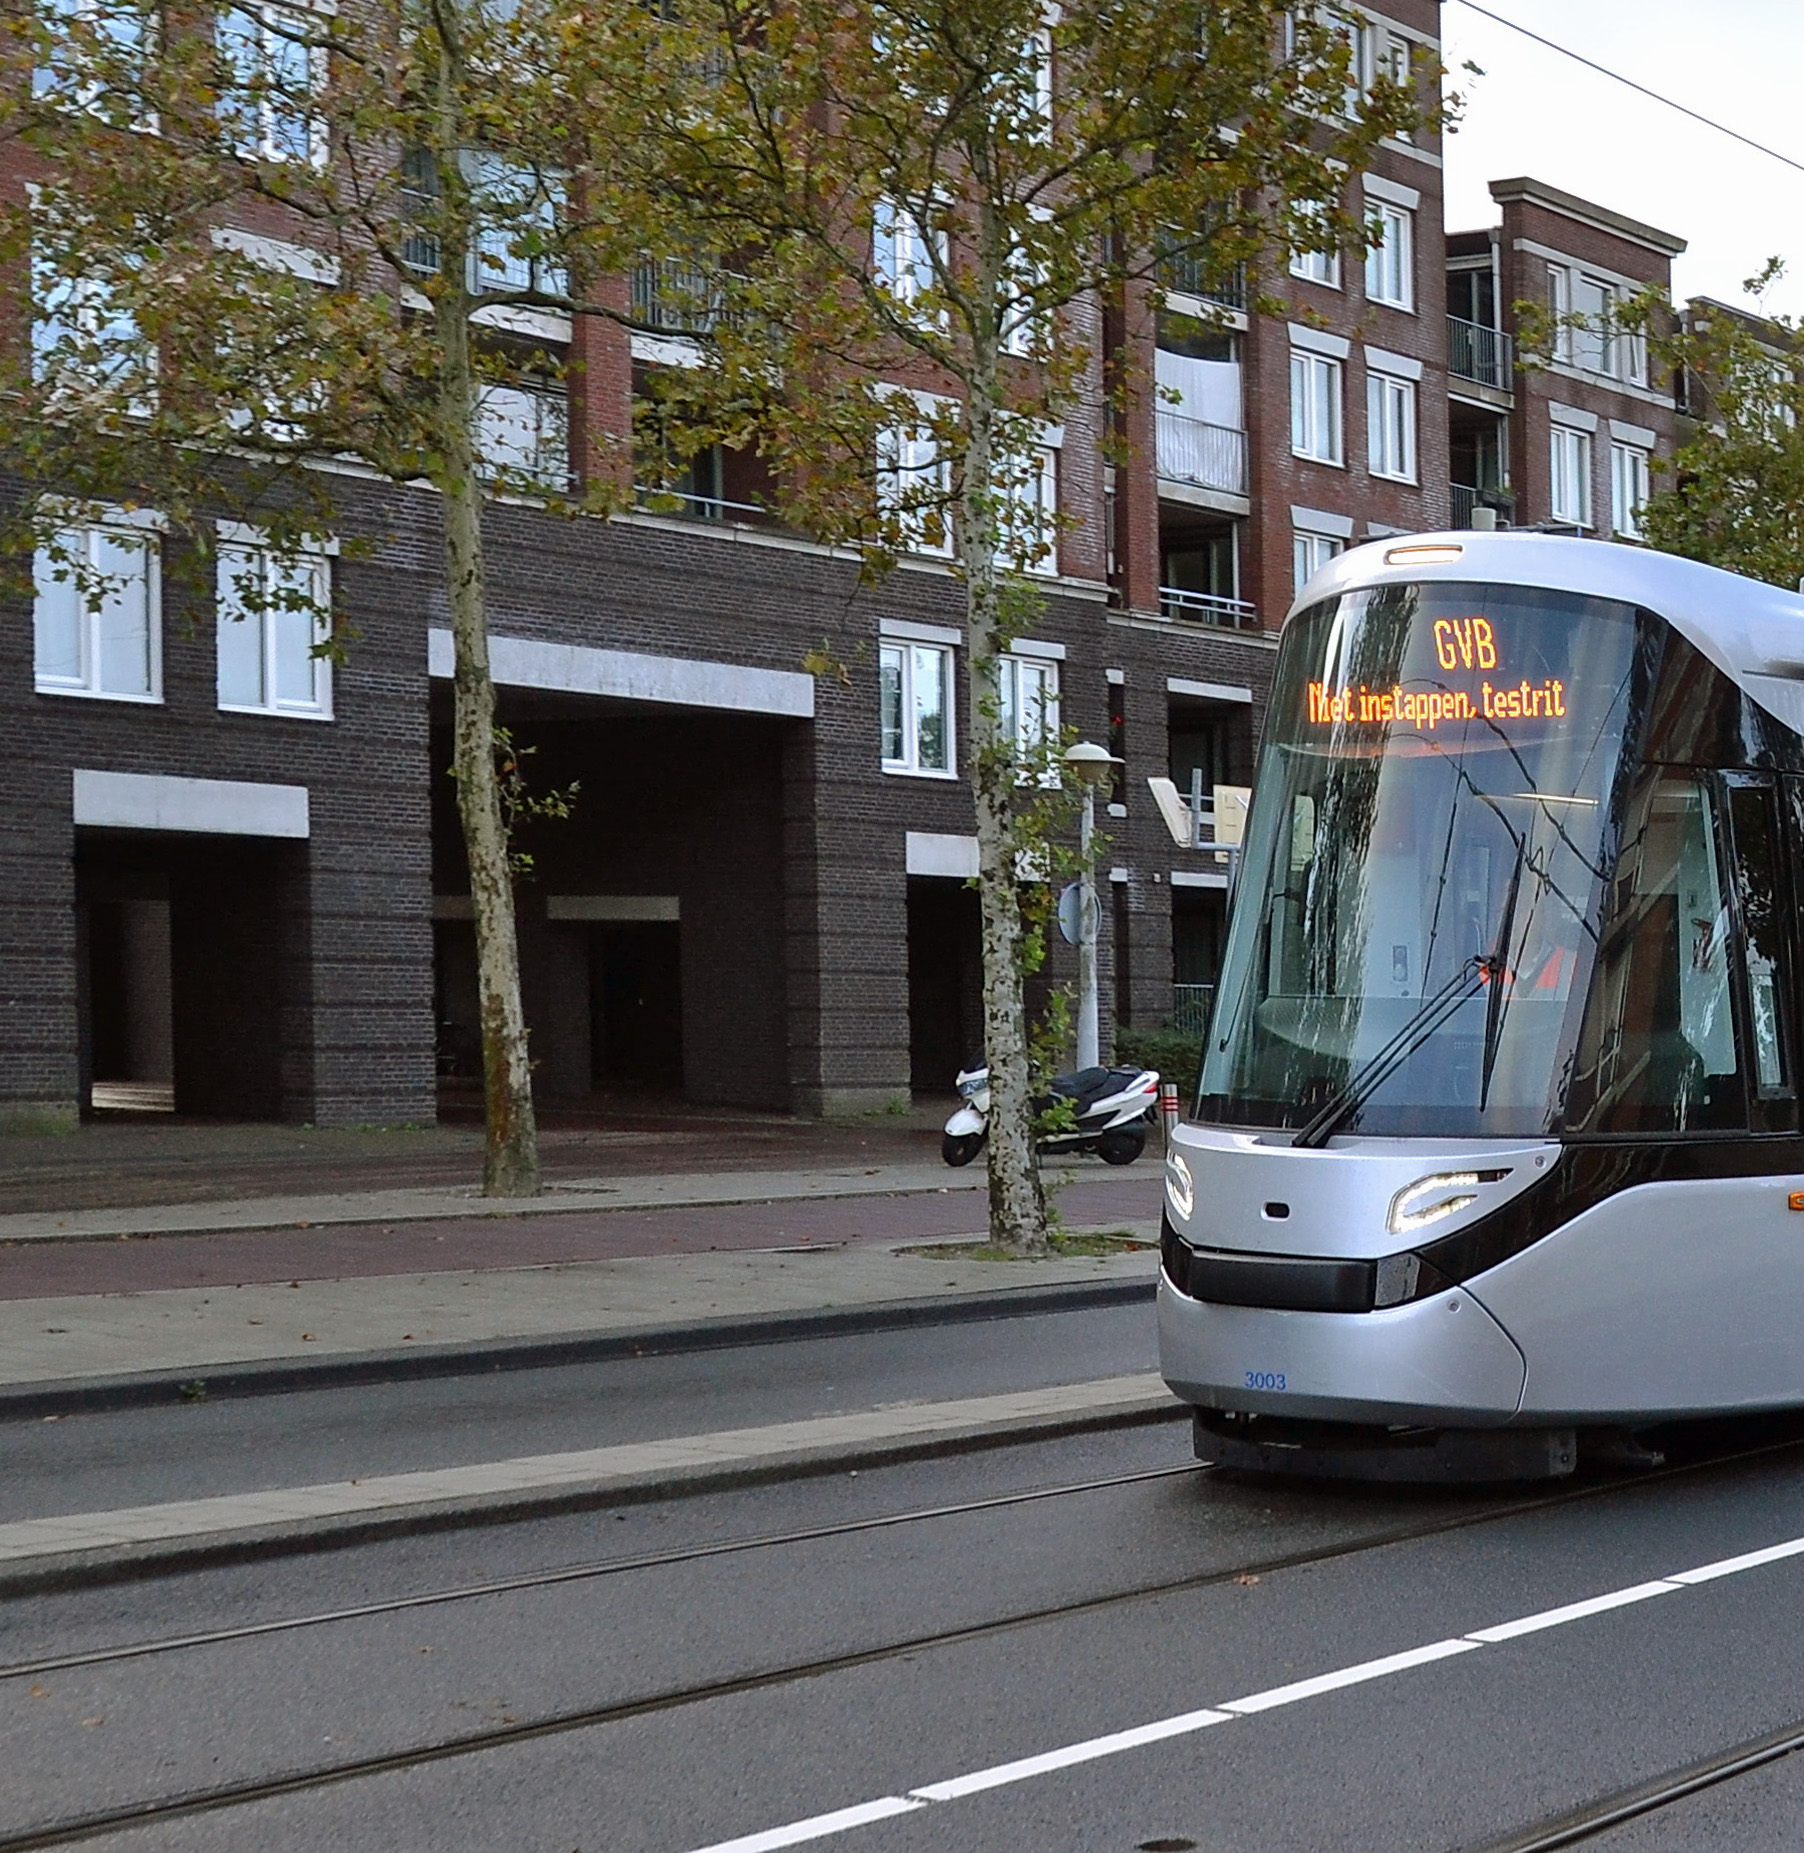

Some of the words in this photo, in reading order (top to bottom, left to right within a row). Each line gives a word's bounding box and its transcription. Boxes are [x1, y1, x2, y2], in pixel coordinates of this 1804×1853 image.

[1433, 618, 1498, 670] GVB
[1307, 681, 1353, 724] Niet
[1359, 685, 1478, 730] instappen,
[1482, 678, 1566, 718] testrit
[1244, 1371, 1287, 1391] 3003
